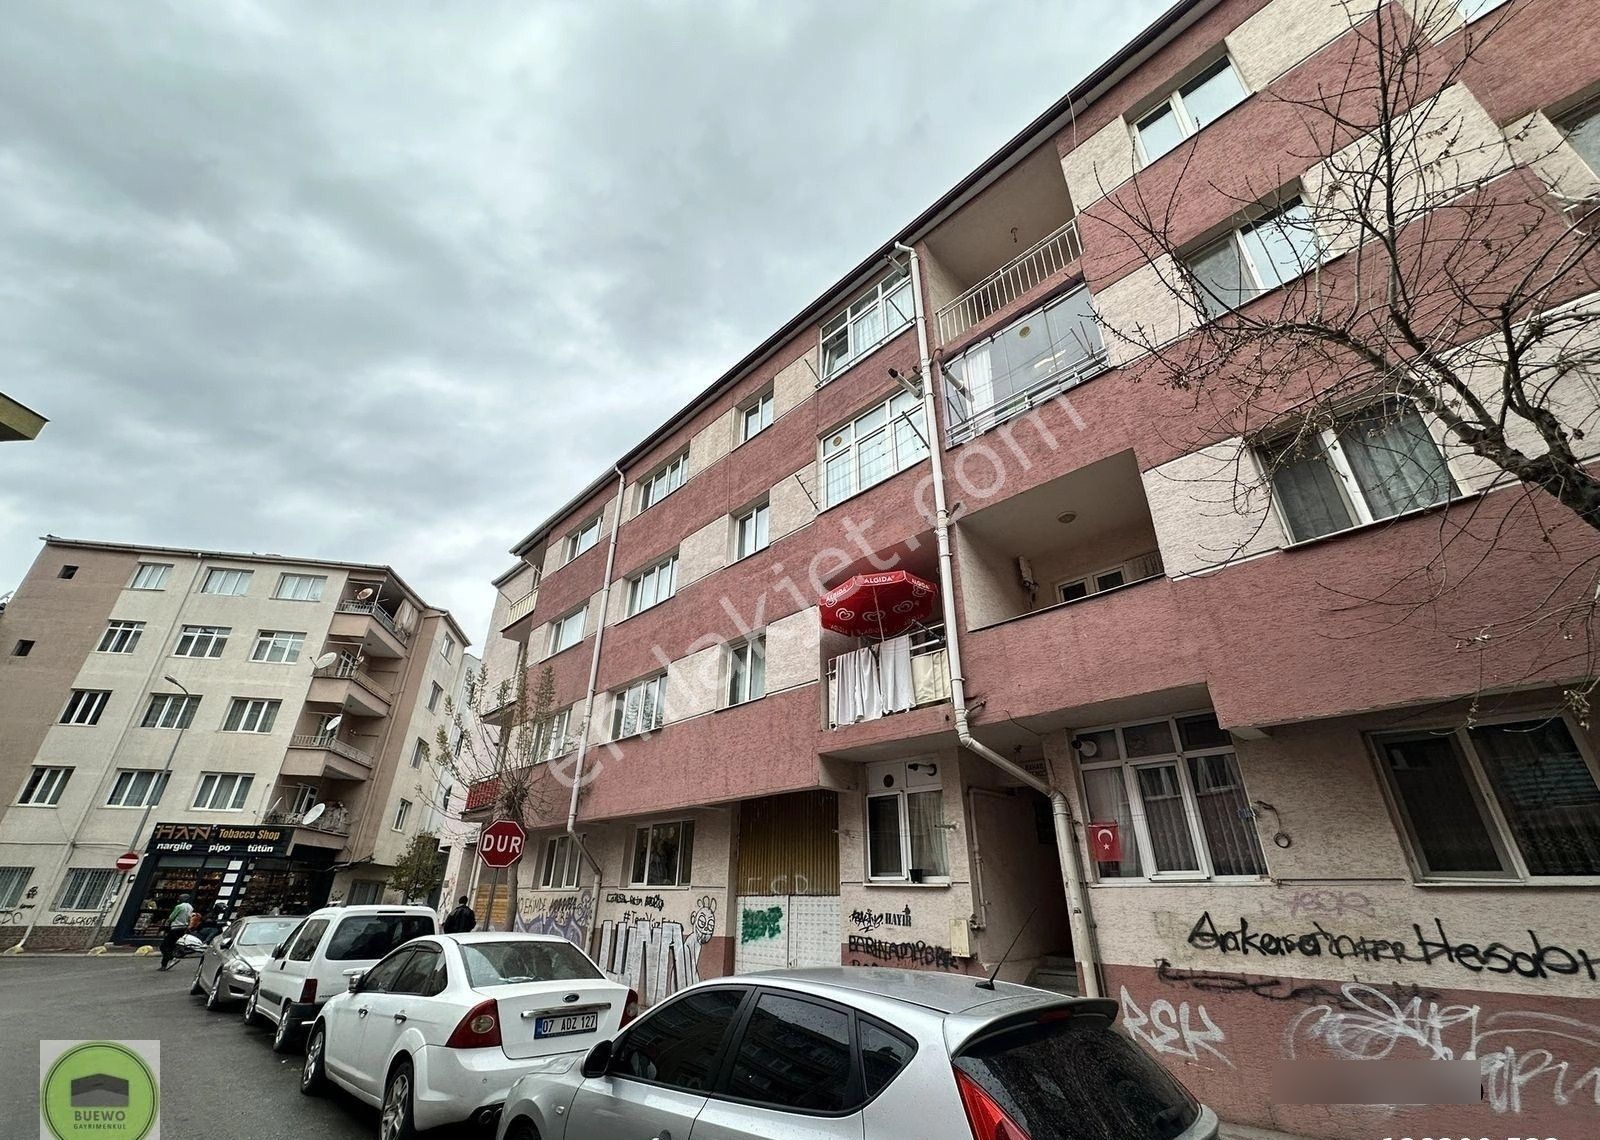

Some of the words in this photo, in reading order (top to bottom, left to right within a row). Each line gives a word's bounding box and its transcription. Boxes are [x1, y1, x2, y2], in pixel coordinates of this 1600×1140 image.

[864, 576, 893, 584] ALGIDA
[156, 824, 212, 841] HAN
[218, 828, 256, 840] Tobacco
[257, 829, 281, 841] Shop
[156, 842, 193, 852] nargile
[208, 843, 231, 853] pipo
[247, 844, 274, 853] tütün
[482, 834, 521, 854] DUR
[543, 1020, 555, 1033] 07
[581, 1015, 596, 1028] 127
